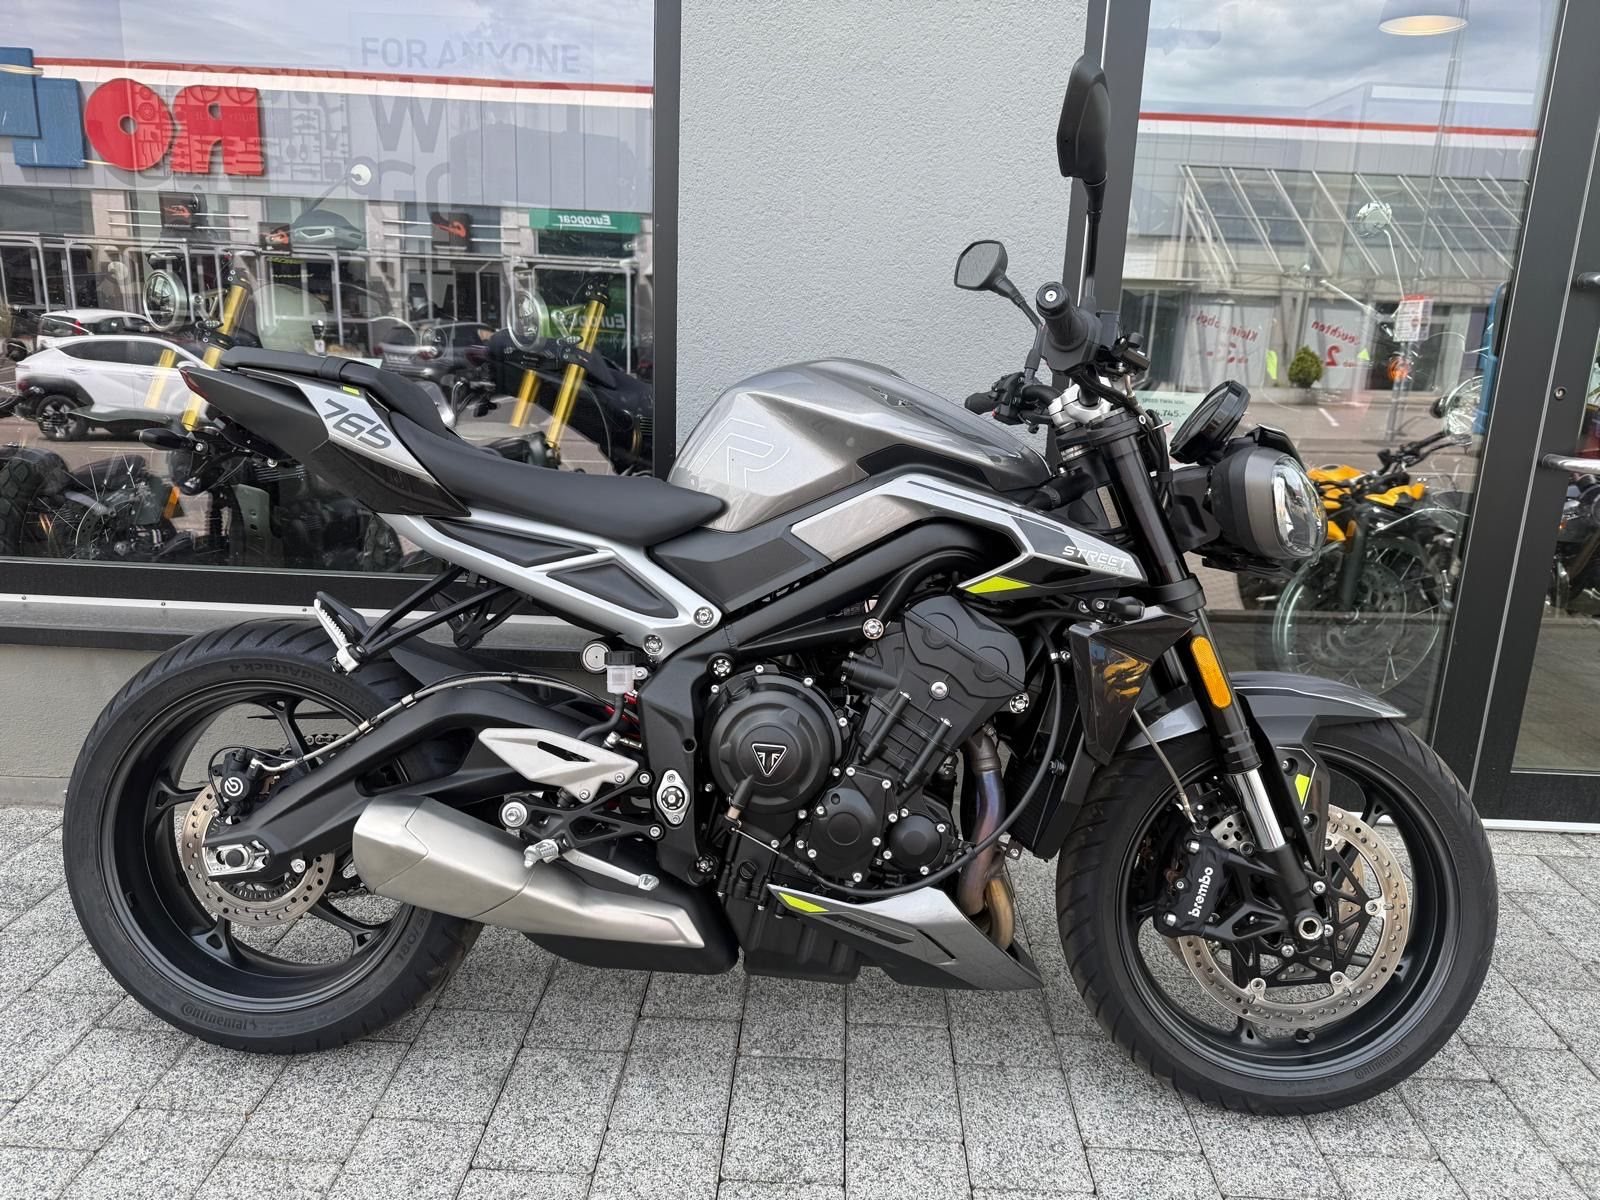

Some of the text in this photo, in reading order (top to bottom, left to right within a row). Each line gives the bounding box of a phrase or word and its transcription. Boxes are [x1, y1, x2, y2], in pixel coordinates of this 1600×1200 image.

[361, 36, 582, 74] FOR ANYONE
[324, 397, 392, 449] 765
[1062, 545, 1131, 569] STREET
[1188, 866, 1214, 918] brembo
[180, 1001, 249, 1032] Continental
